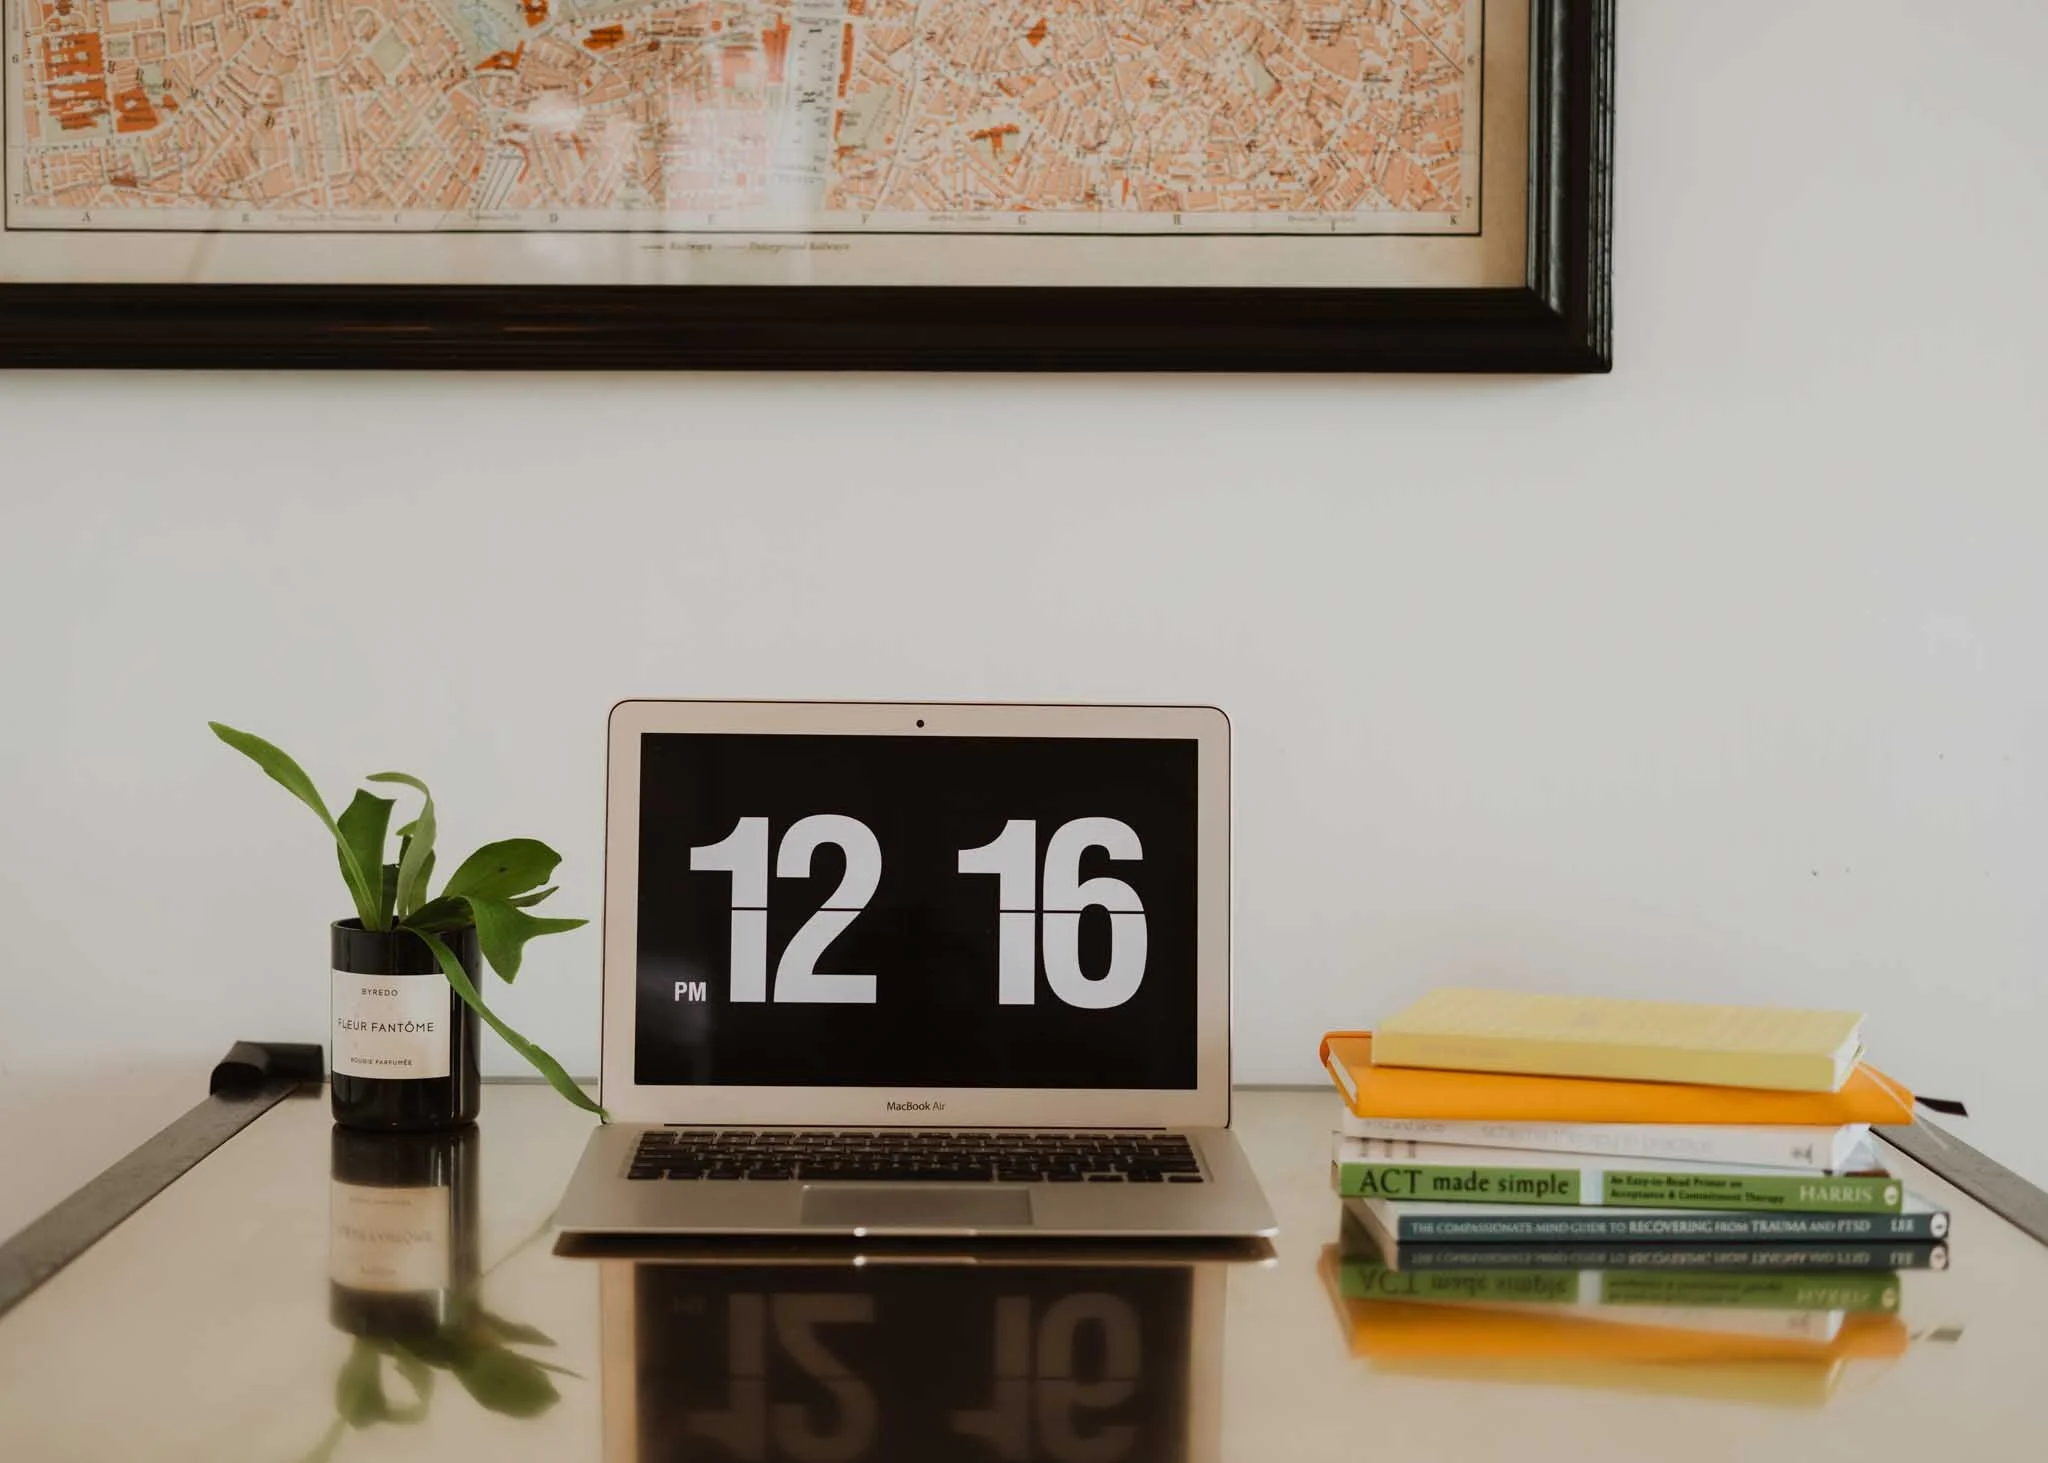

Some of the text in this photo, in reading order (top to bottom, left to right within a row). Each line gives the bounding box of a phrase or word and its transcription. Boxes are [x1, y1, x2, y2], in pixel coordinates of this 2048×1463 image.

[690, 814, 1148, 1009] 12 16
[361, 988, 398, 997] BYREDO
[674, 981, 707, 1002] PM
[338, 1018, 434, 1032] FLEUR FANTÔME
[887, 1101, 945, 1111] MacBook Air
[1360, 1168, 1569, 1198] ACT made simple
[1800, 1185, 1873, 1202] HARRIS
[1411, 1222, 1433, 1233] THE
[1609, 1222, 1627, 1233] TO
[1628, 1220, 1713, 1235] RECOVERING
[1714, 1222, 1748, 1233] FROM
[1751, 1220, 1806, 1234] TRAUMA
[1809, 1222, 1836, 1233] AND
[1837, 1220, 1871, 1234] PTSD
[1890, 1220, 1914, 1234] LEE
